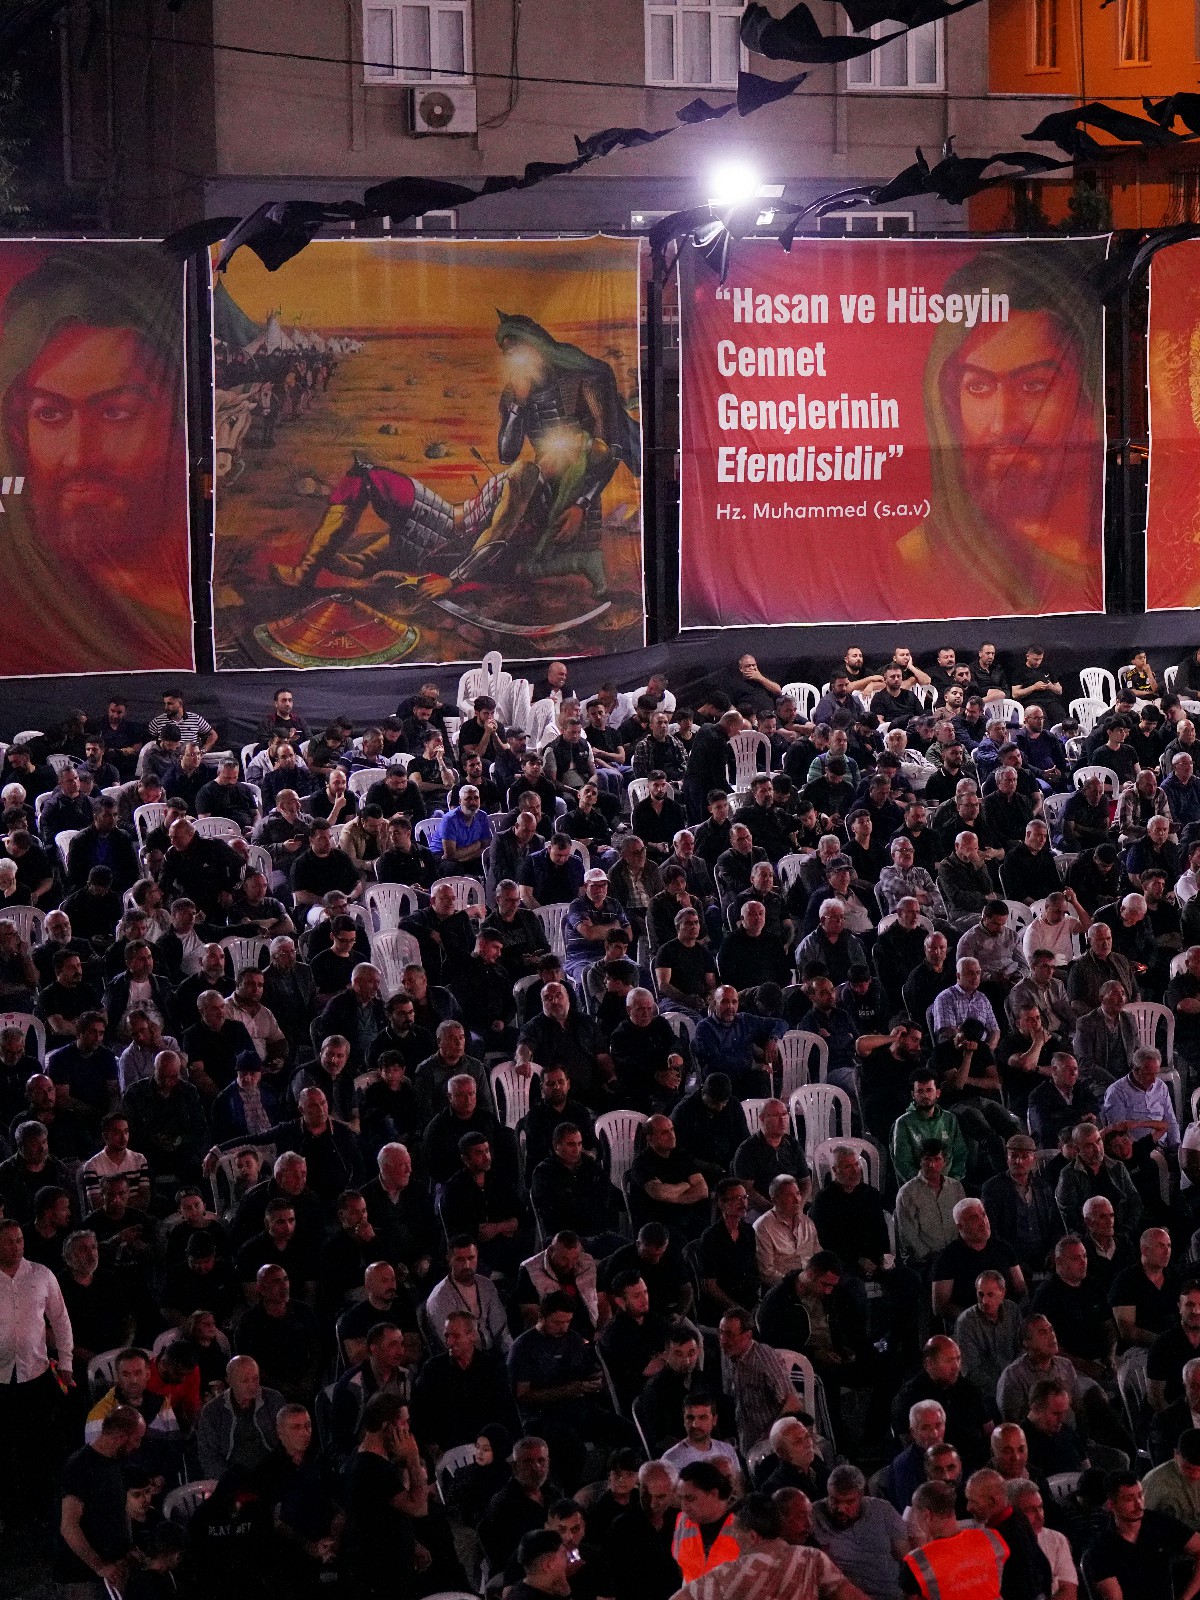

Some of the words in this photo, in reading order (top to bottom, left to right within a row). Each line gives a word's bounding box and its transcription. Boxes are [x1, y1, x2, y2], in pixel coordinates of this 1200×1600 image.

[716, 286, 829, 324] “Hasan
[840, 294, 876, 324] ve
[887, 286, 1010, 328] Hüseyin
[717, 339, 827, 377] Cennet
[717, 392, 900, 435] Gençlerinin
[717, 444, 904, 483] Efendisidir”
[716, 503, 747, 520] Hz.
[753, 500, 868, 520] Muhammed
[873, 499, 931, 520] (s.a.v)
